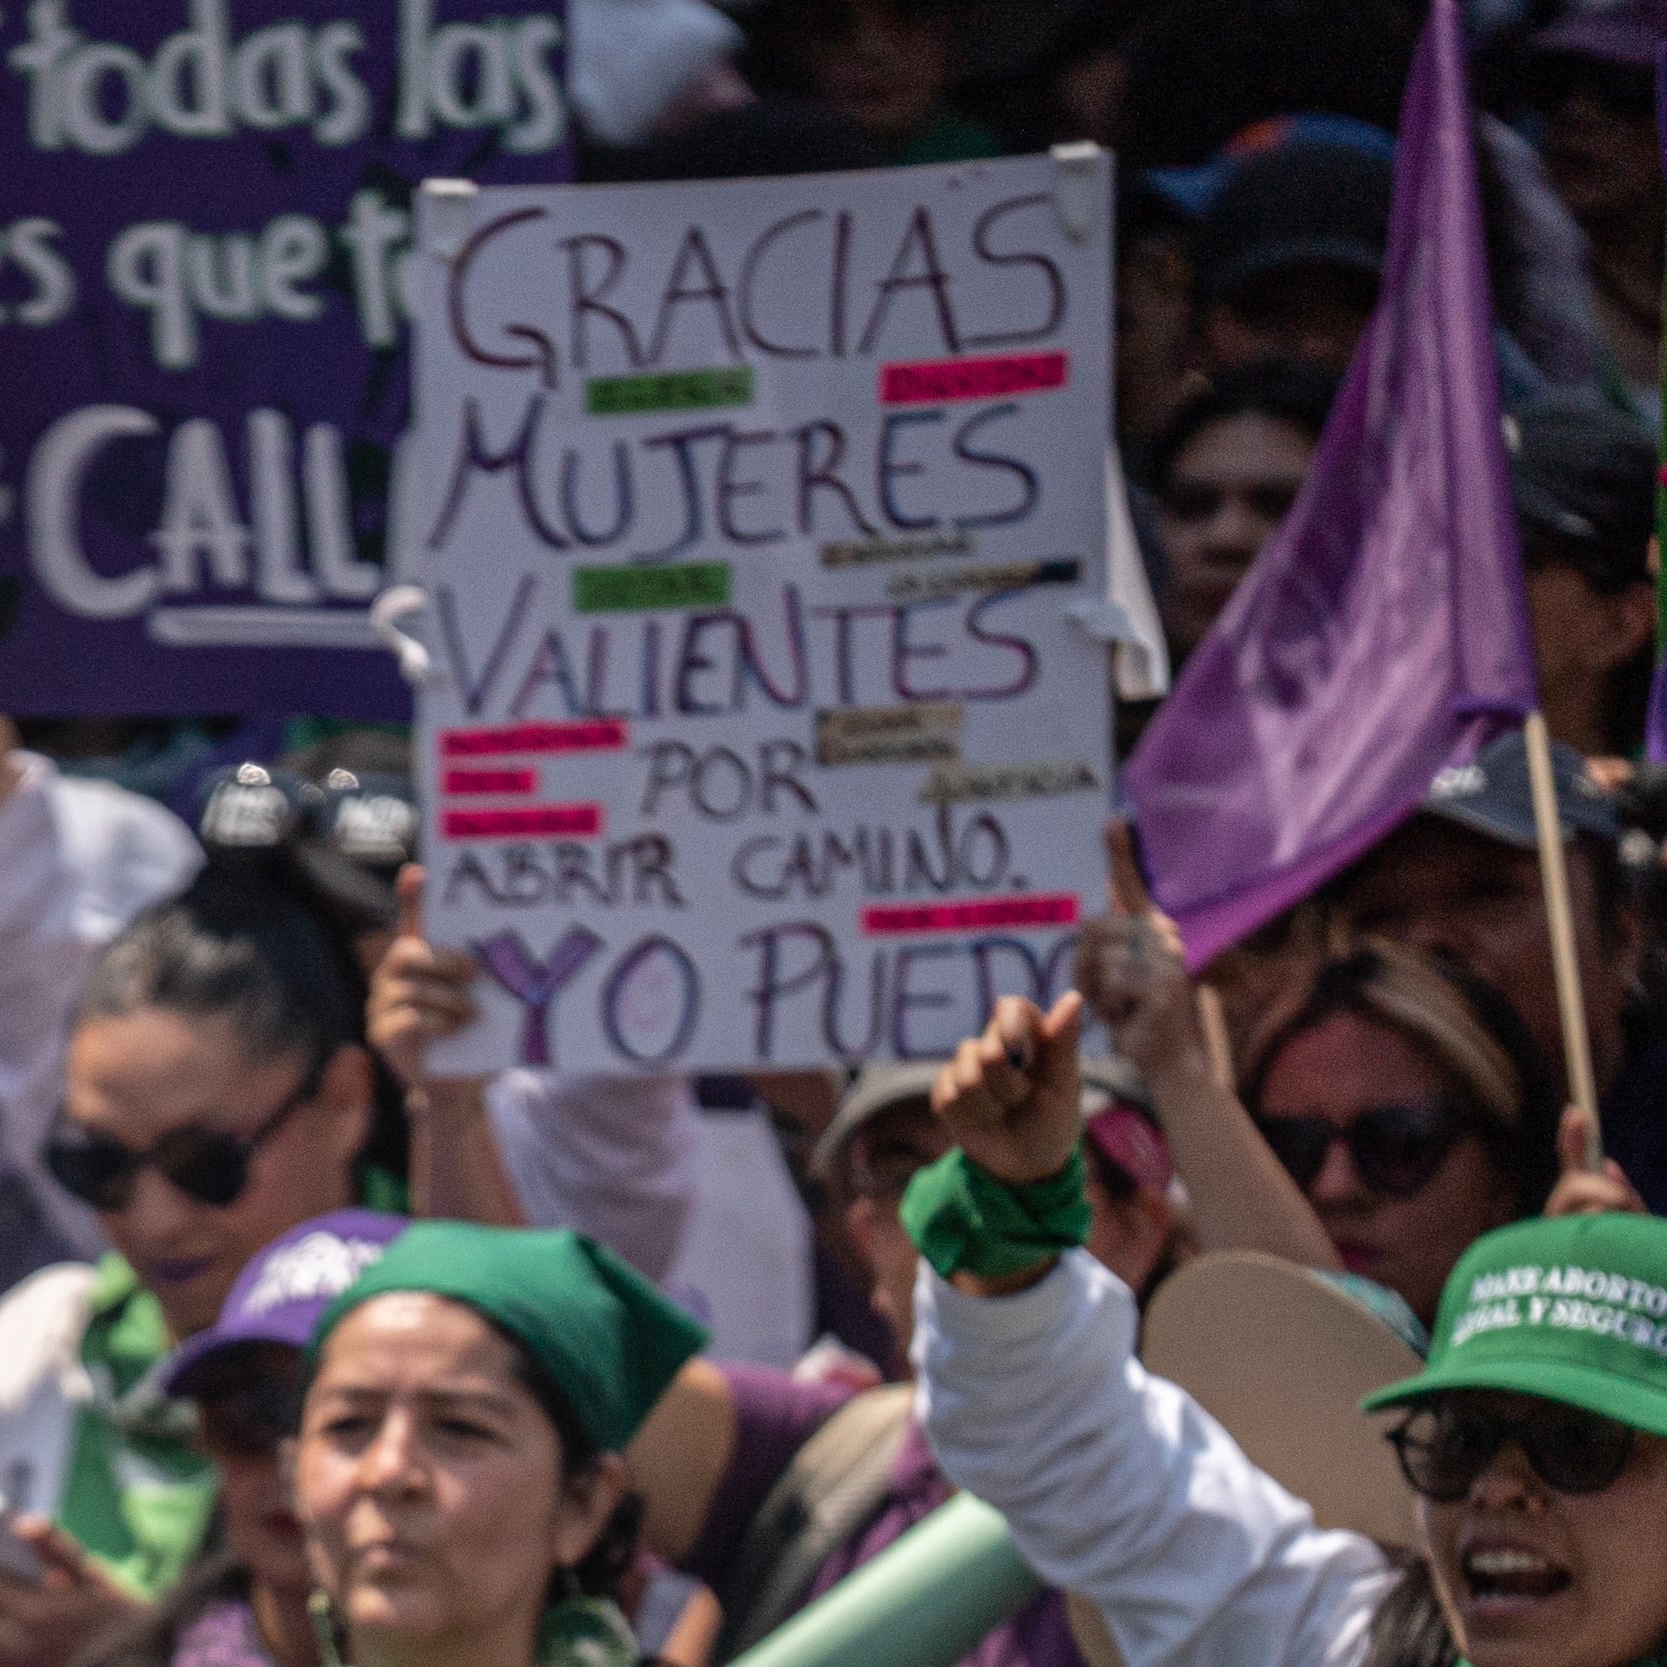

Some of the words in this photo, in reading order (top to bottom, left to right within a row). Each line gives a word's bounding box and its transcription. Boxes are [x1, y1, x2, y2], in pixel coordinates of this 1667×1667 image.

[14, 0, 365, 155] todas
[397, 0, 569, 152] las
[108, 217, 326, 367] que
[346, 191, 415, 349] t
[446, 193, 1070, 391] GRACIAS
[26, 406, 387, 617] CALL
[428, 393, 1038, 564] MUJERES
[435, 571, 1038, 717] VALIENTES
[640, 738, 818, 822] POR
[473, 924, 699, 1064] YO
[741, 922, 1079, 1059] PUED
